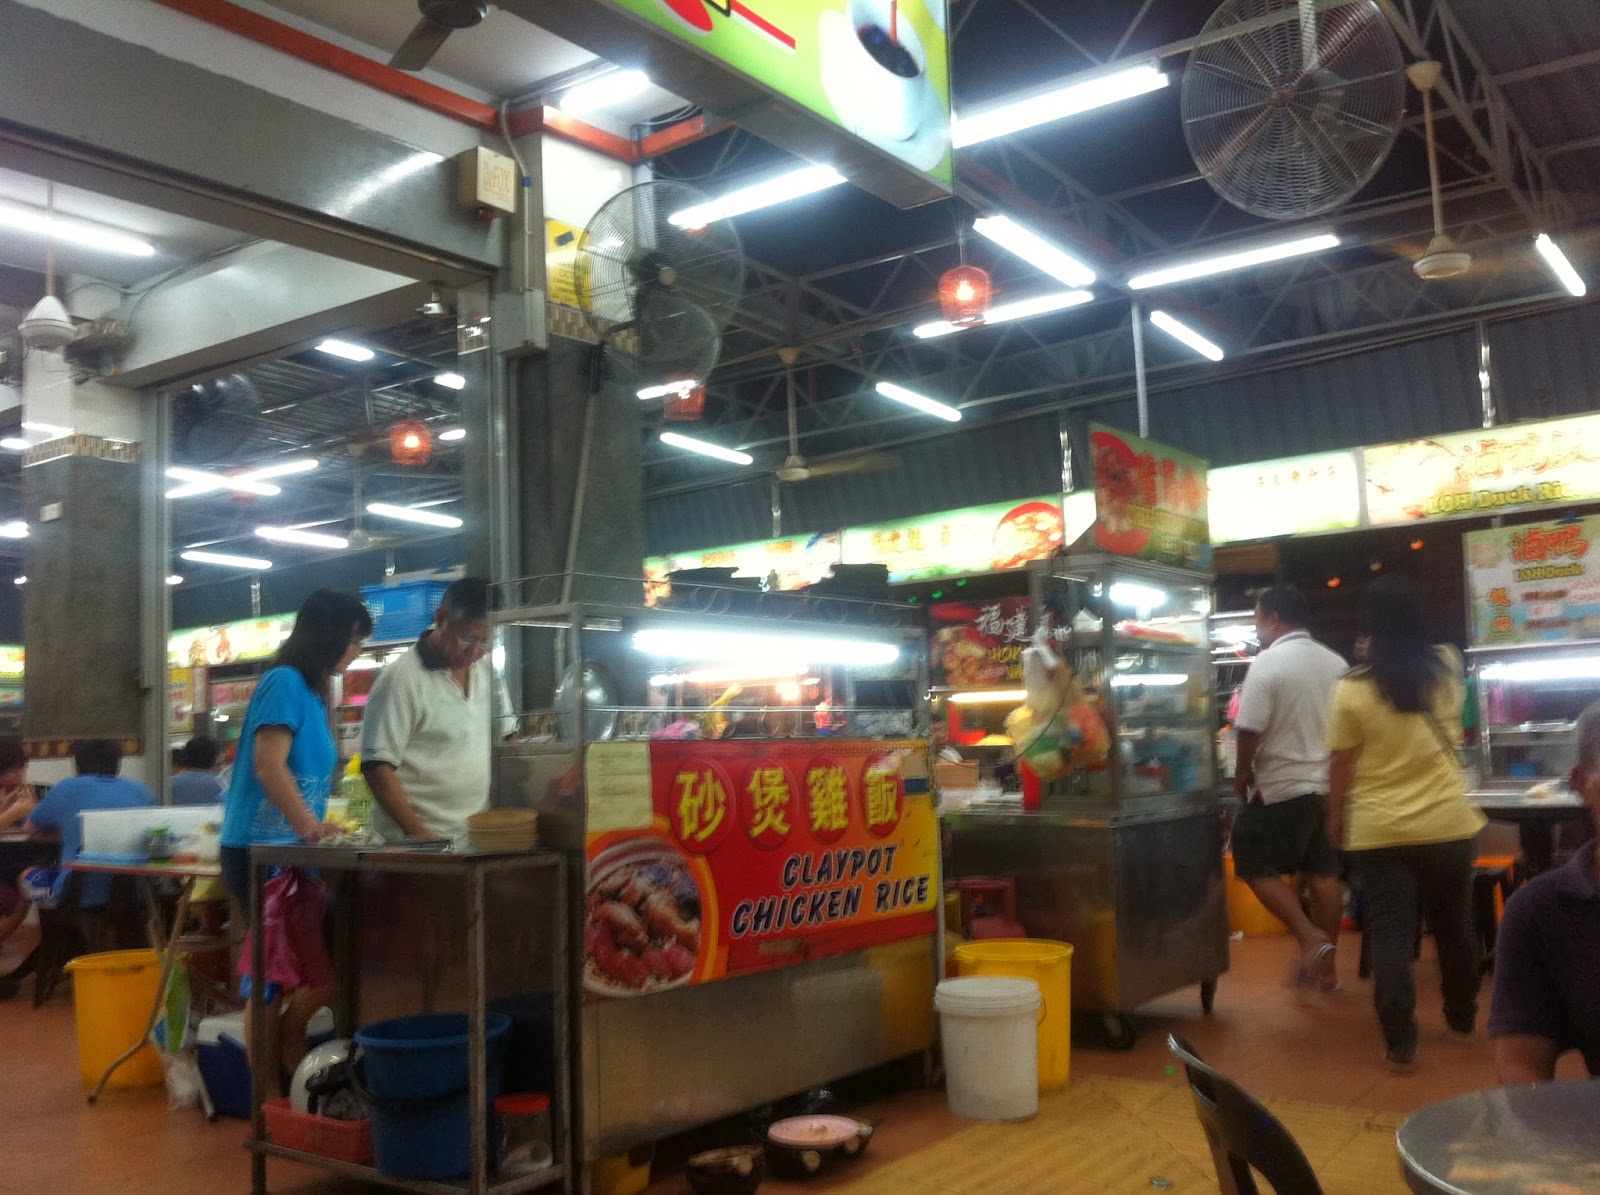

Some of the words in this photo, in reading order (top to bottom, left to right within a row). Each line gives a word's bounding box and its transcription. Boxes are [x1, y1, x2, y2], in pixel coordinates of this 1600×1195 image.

[1536, 480, 1583, 501] Ric
[782, 843, 898, 890] CLAYPOT
[730, 884, 863, 939] CHICKEN
[875, 874, 930, 915] RICE
